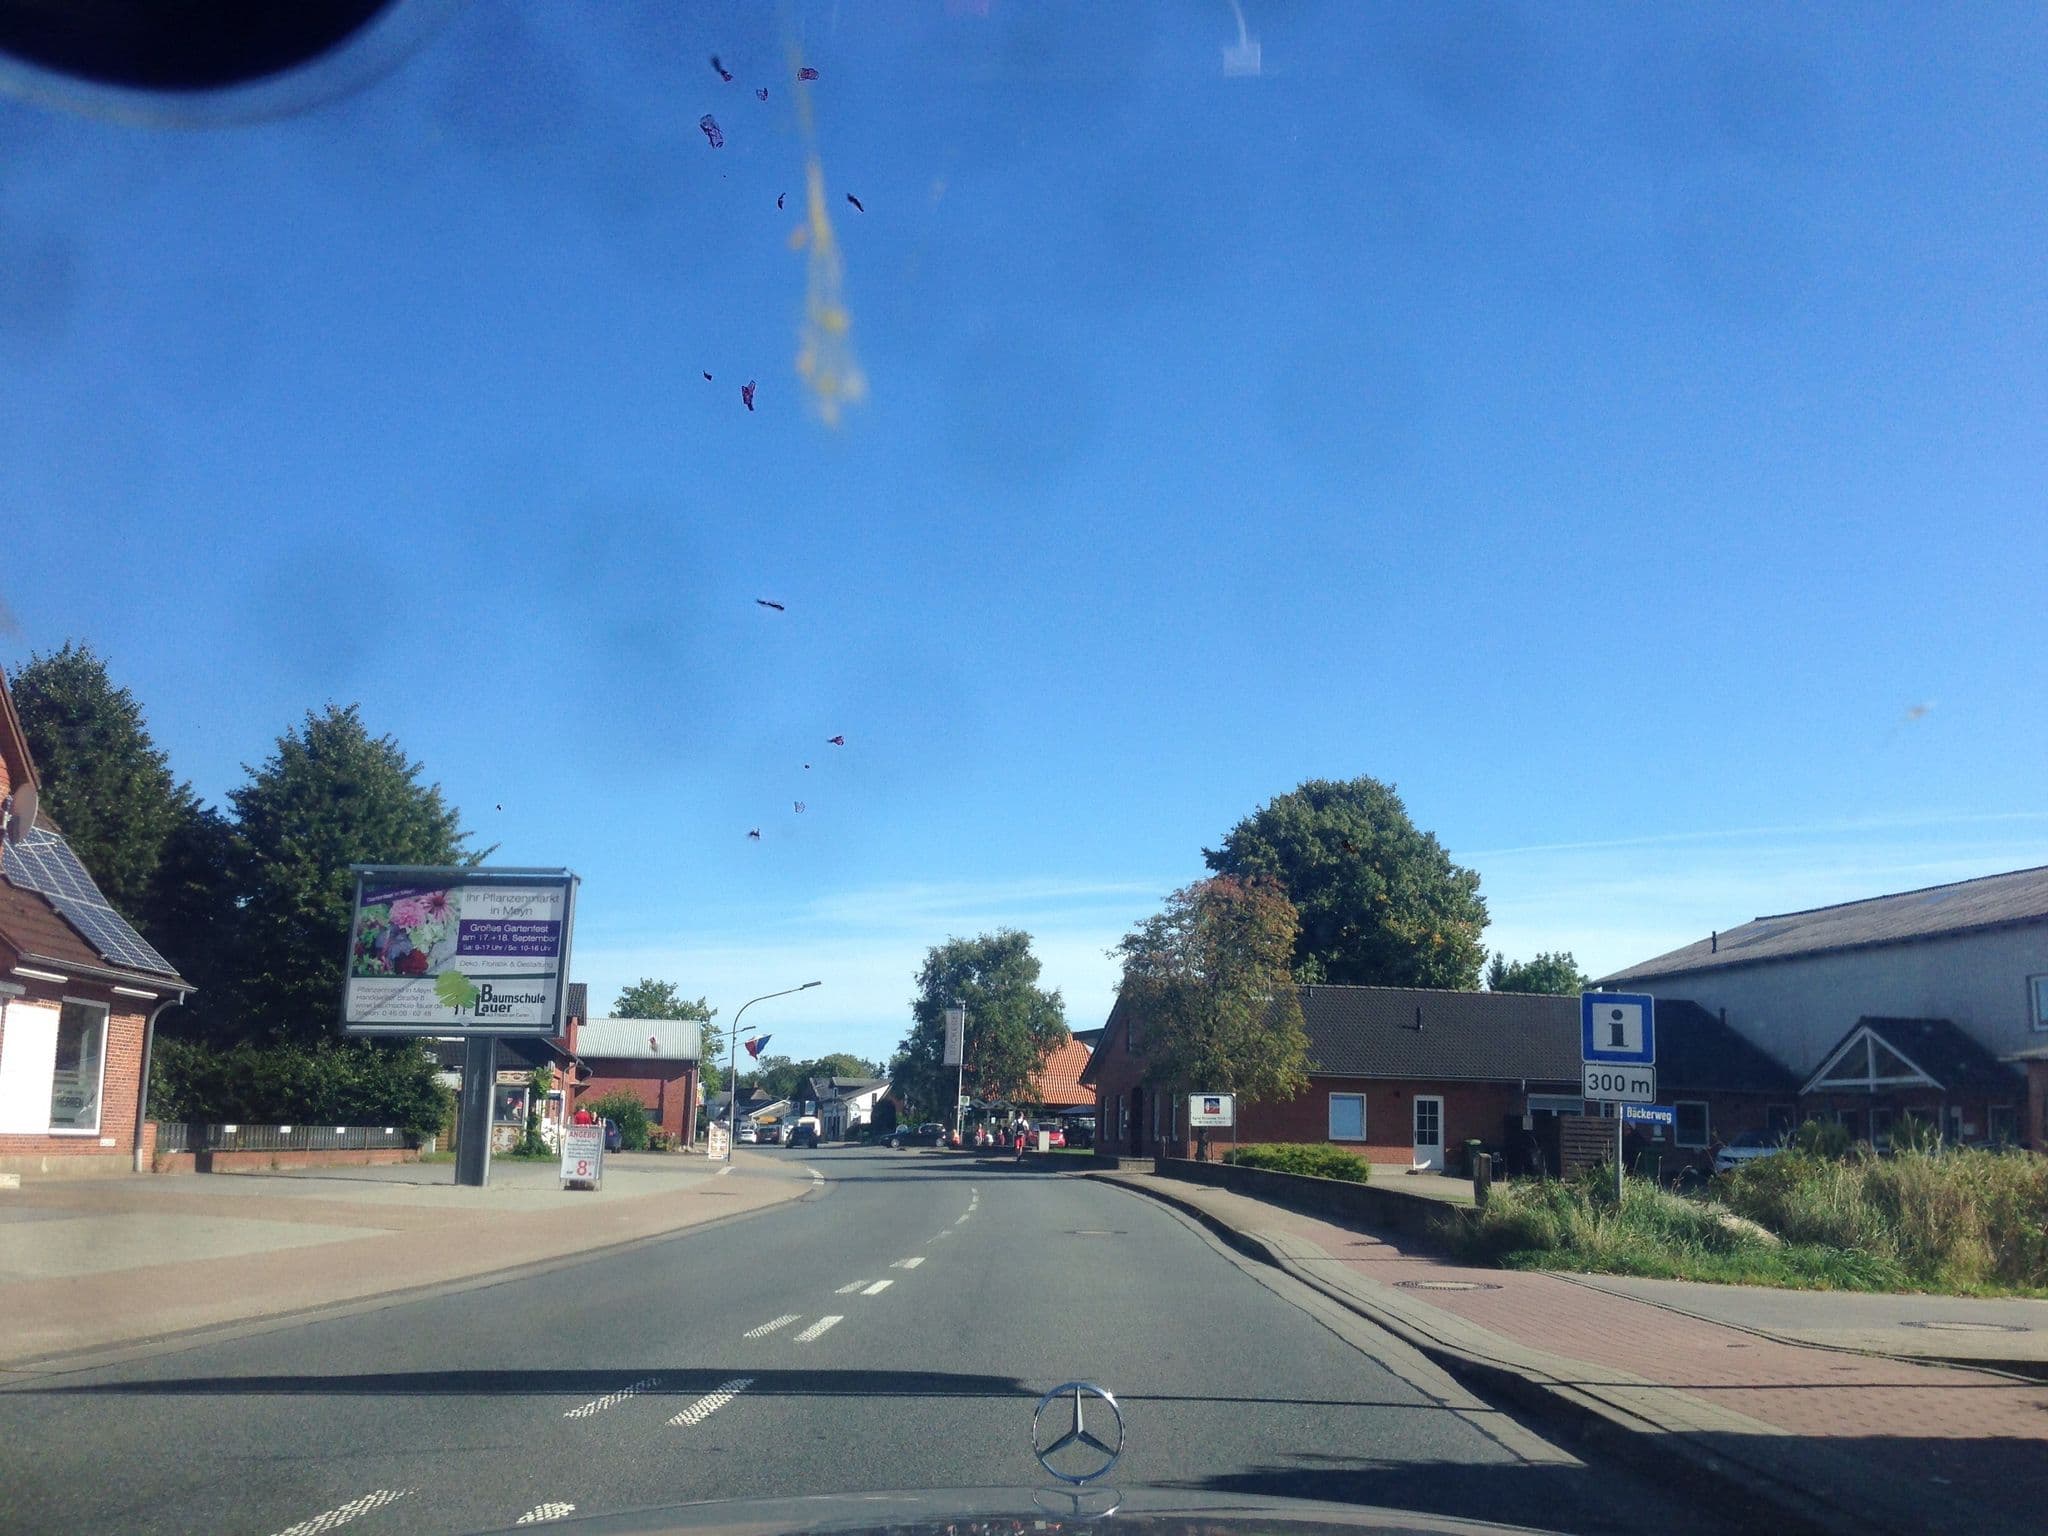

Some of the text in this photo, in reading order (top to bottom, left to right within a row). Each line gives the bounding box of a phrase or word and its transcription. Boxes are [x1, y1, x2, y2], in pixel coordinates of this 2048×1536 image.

[465, 892, 561, 904] Ihr Pflanzenmarkt
[490, 906, 533, 917] in Meyn
[470, 923, 550, 933] Großes Gartenfest
[511, 934, 557, 944] September
[516, 960, 554, 969] Gestaltung
[480, 983, 546, 1004] Baumschule
[474, 993, 513, 1017] Lauer
[1587, 1073, 1650, 1094] 300 m
[1626, 1106, 1673, 1124] Bäckerweg
